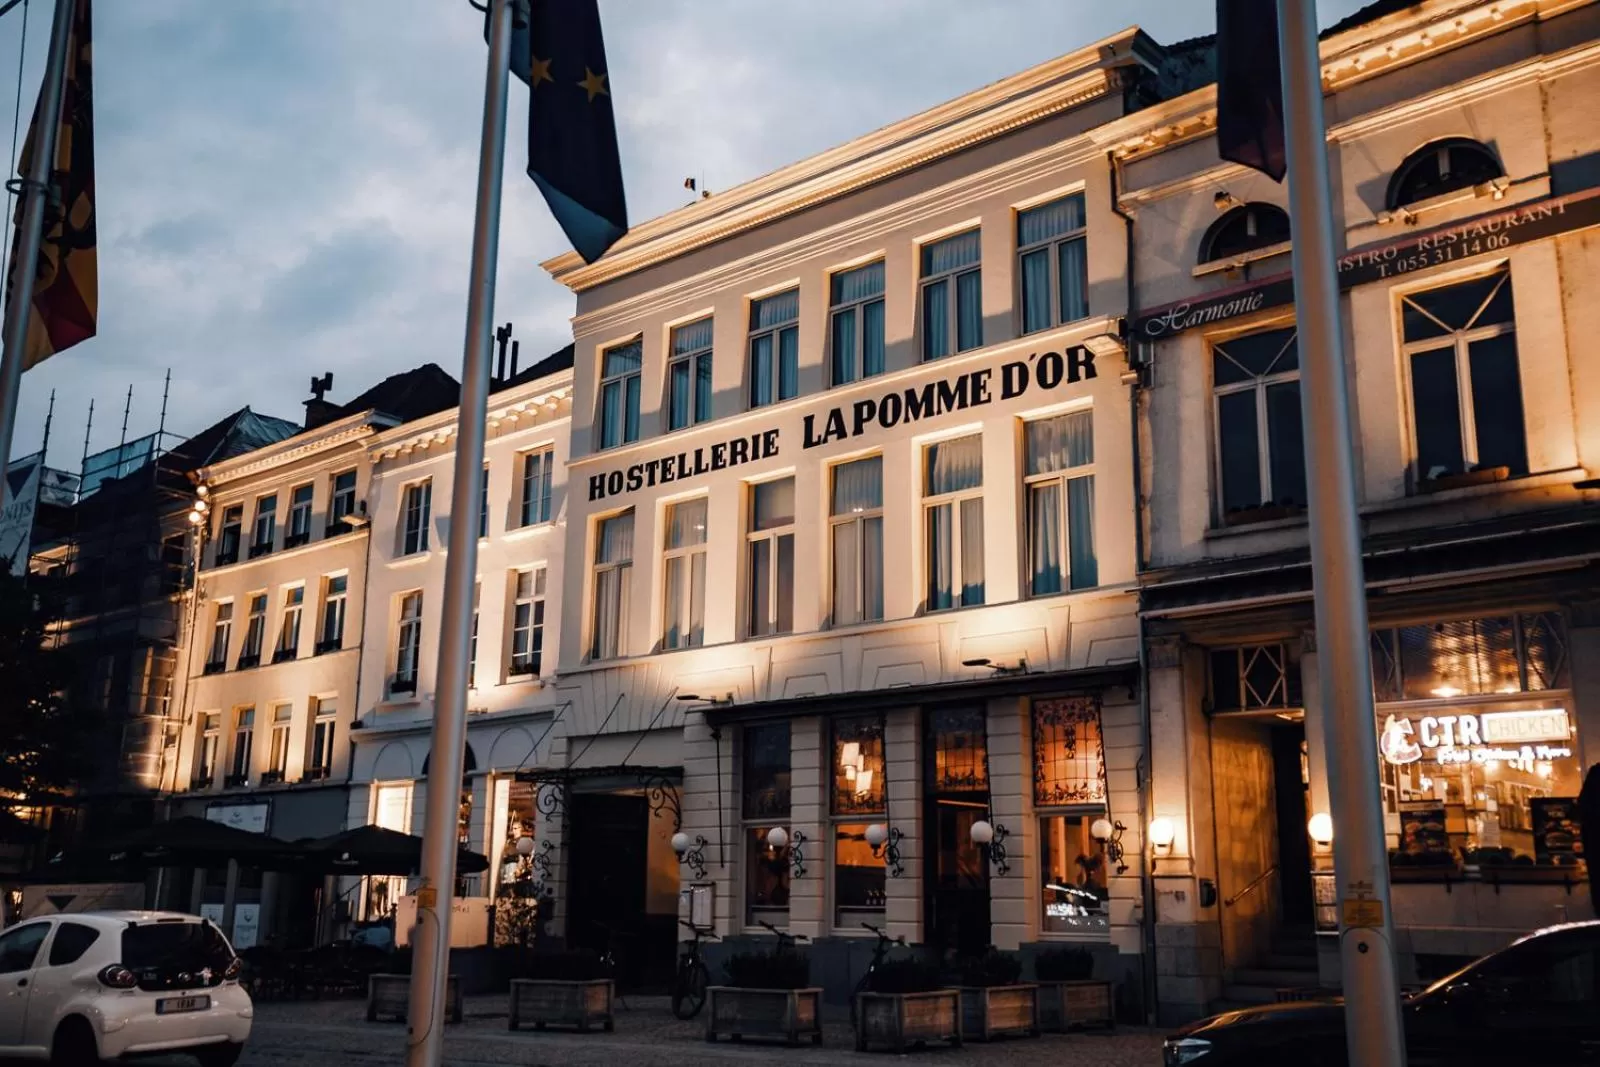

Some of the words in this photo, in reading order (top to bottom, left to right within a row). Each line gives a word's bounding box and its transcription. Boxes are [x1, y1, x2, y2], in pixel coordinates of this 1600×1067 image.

[1336, 245, 1398, 274] ISTRO
[1417, 201, 1567, 251] RESTAURANT
[1376, 264, 1392, 279] T.
[1397, 252, 1429, 274] 055
[1434, 246, 1454, 265] 31
[1461, 238, 1482, 257] 14
[1487, 231, 1511, 249] 06
[1145, 291, 1264, 336] Harmonie
[588, 429, 780, 502] HOSTELLERIE
[1000, 343, 1098, 401] D'OR
[1420, 714, 1481, 747] CTR
[1487, 715, 1564, 737] CHICKEN
